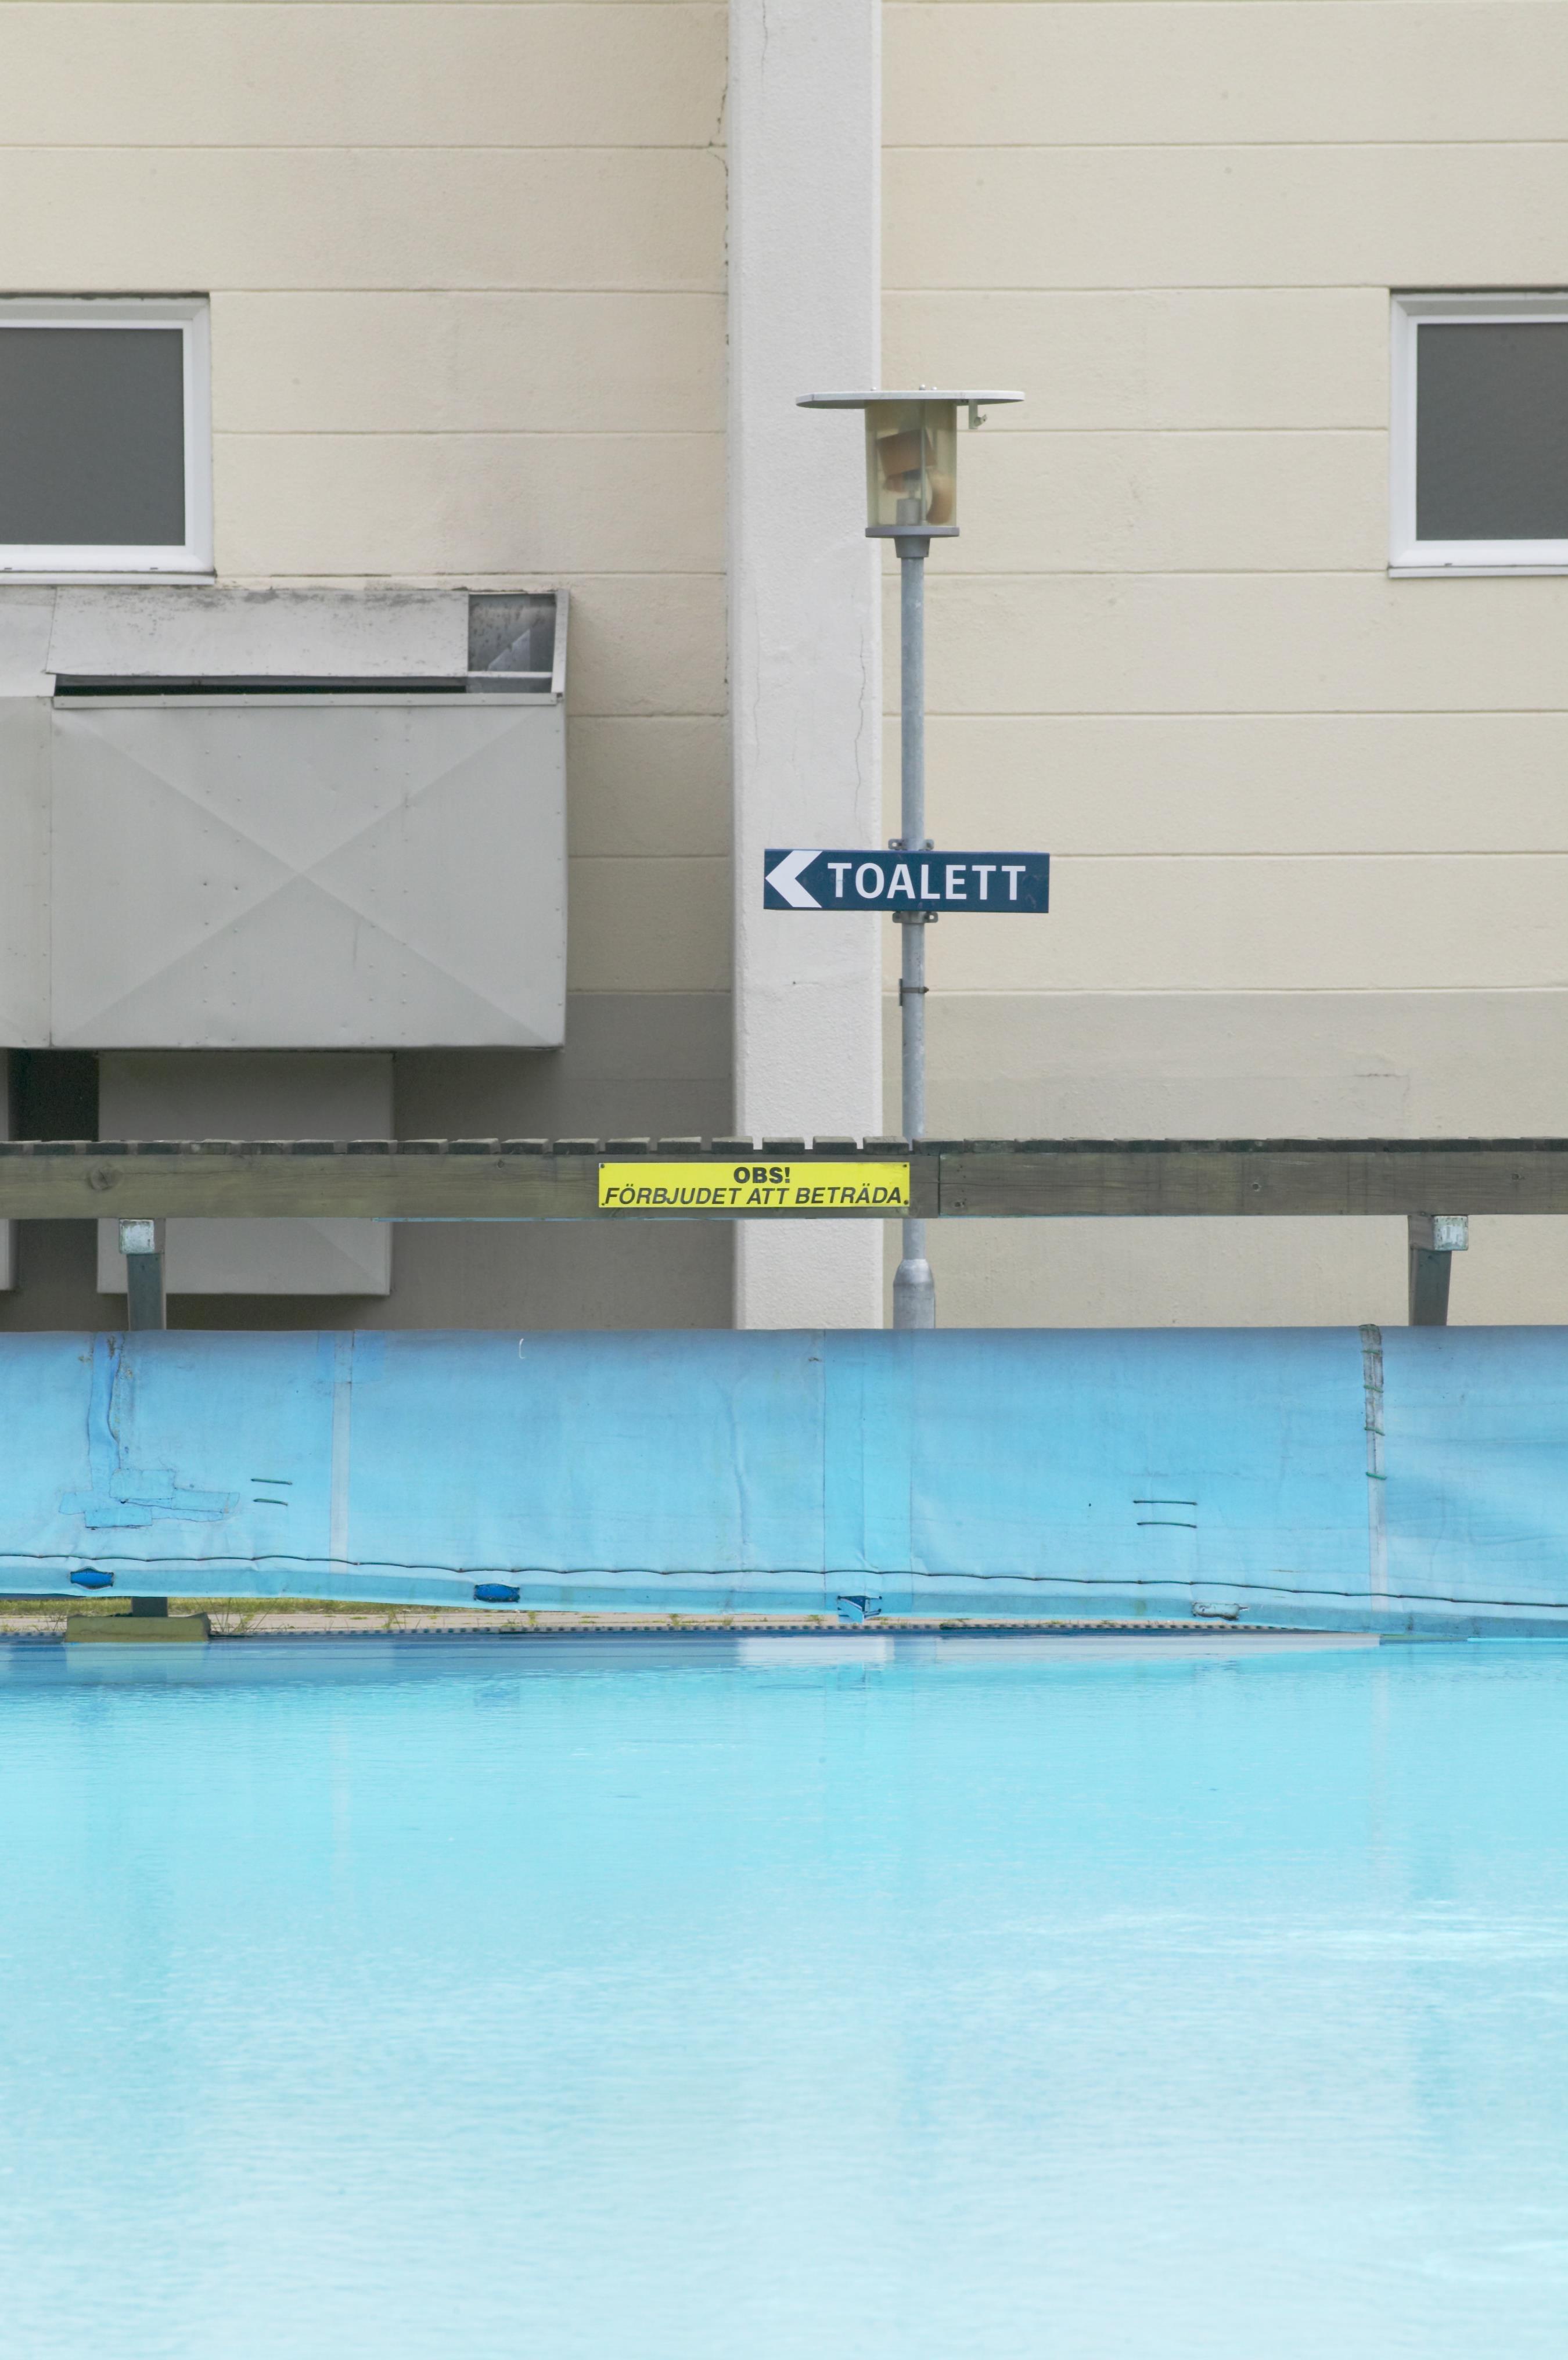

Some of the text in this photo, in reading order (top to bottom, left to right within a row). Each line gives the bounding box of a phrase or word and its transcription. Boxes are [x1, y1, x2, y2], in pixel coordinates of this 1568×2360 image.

[827, 862, 1026, 901] TOALETT
[733, 1167, 790, 1183] OBS!
[605, 1183, 901, 1204] FÖRBJUDET ATT BETRÄDA
